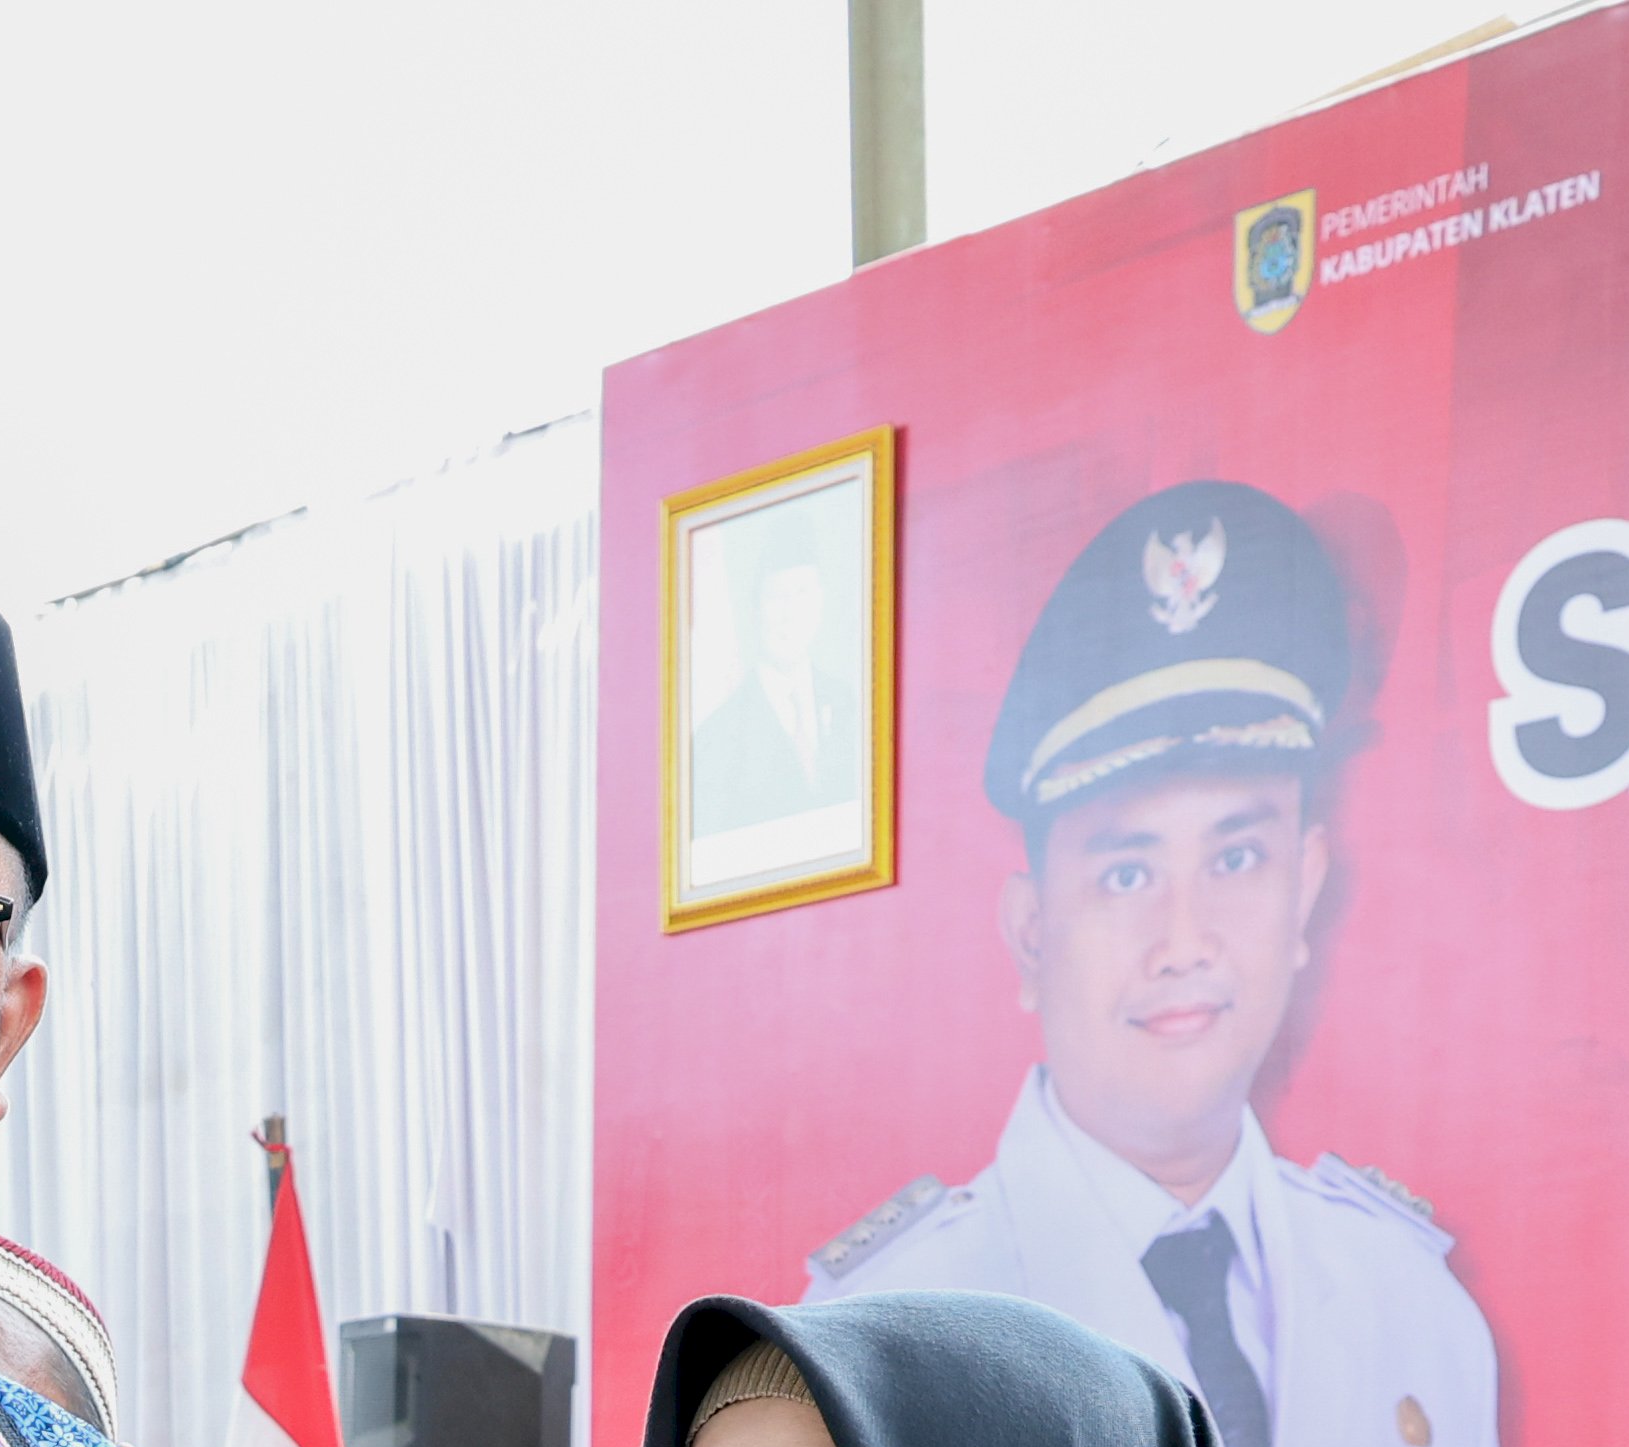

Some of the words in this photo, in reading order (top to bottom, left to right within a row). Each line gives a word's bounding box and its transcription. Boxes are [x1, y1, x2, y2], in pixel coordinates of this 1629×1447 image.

[1321, 164, 1490, 241] PEMERINTAH
[1321, 206, 1483, 284] KABUPATEN
[1489, 172, 1601, 232] KLATEN
